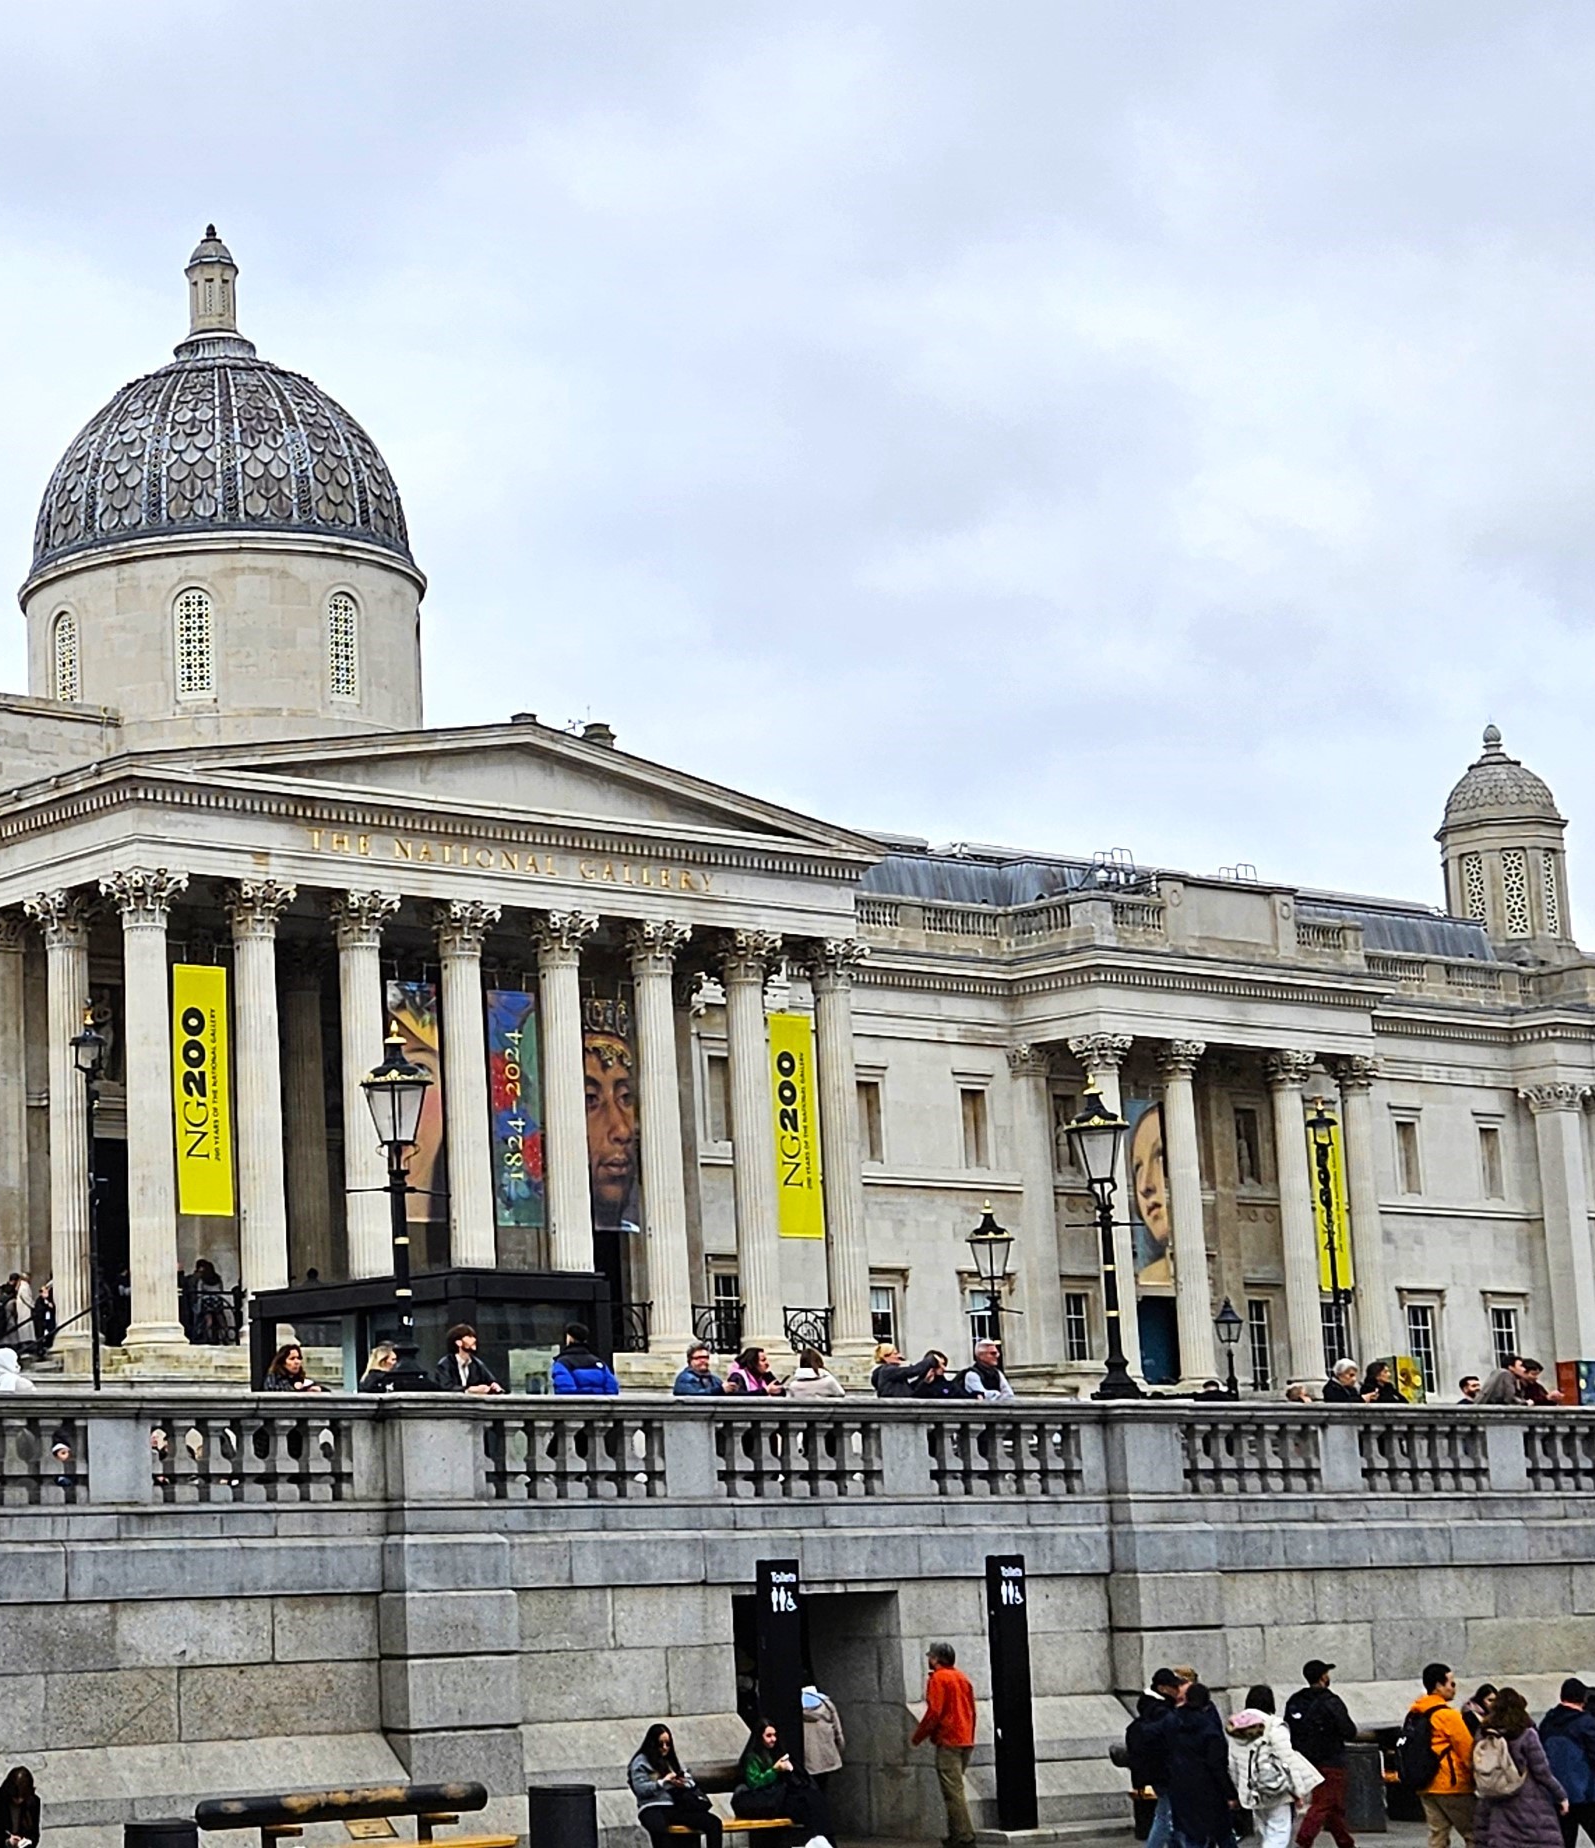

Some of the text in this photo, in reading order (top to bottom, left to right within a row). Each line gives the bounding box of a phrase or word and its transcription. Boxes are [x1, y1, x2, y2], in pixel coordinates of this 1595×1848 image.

[307, 828, 714, 892] THE NATIONAL GALLERY
[181, 1006, 210, 1160] NG200
[212, 1107, 219, 1117] OF
[776, 1051, 804, 1188] NG200
